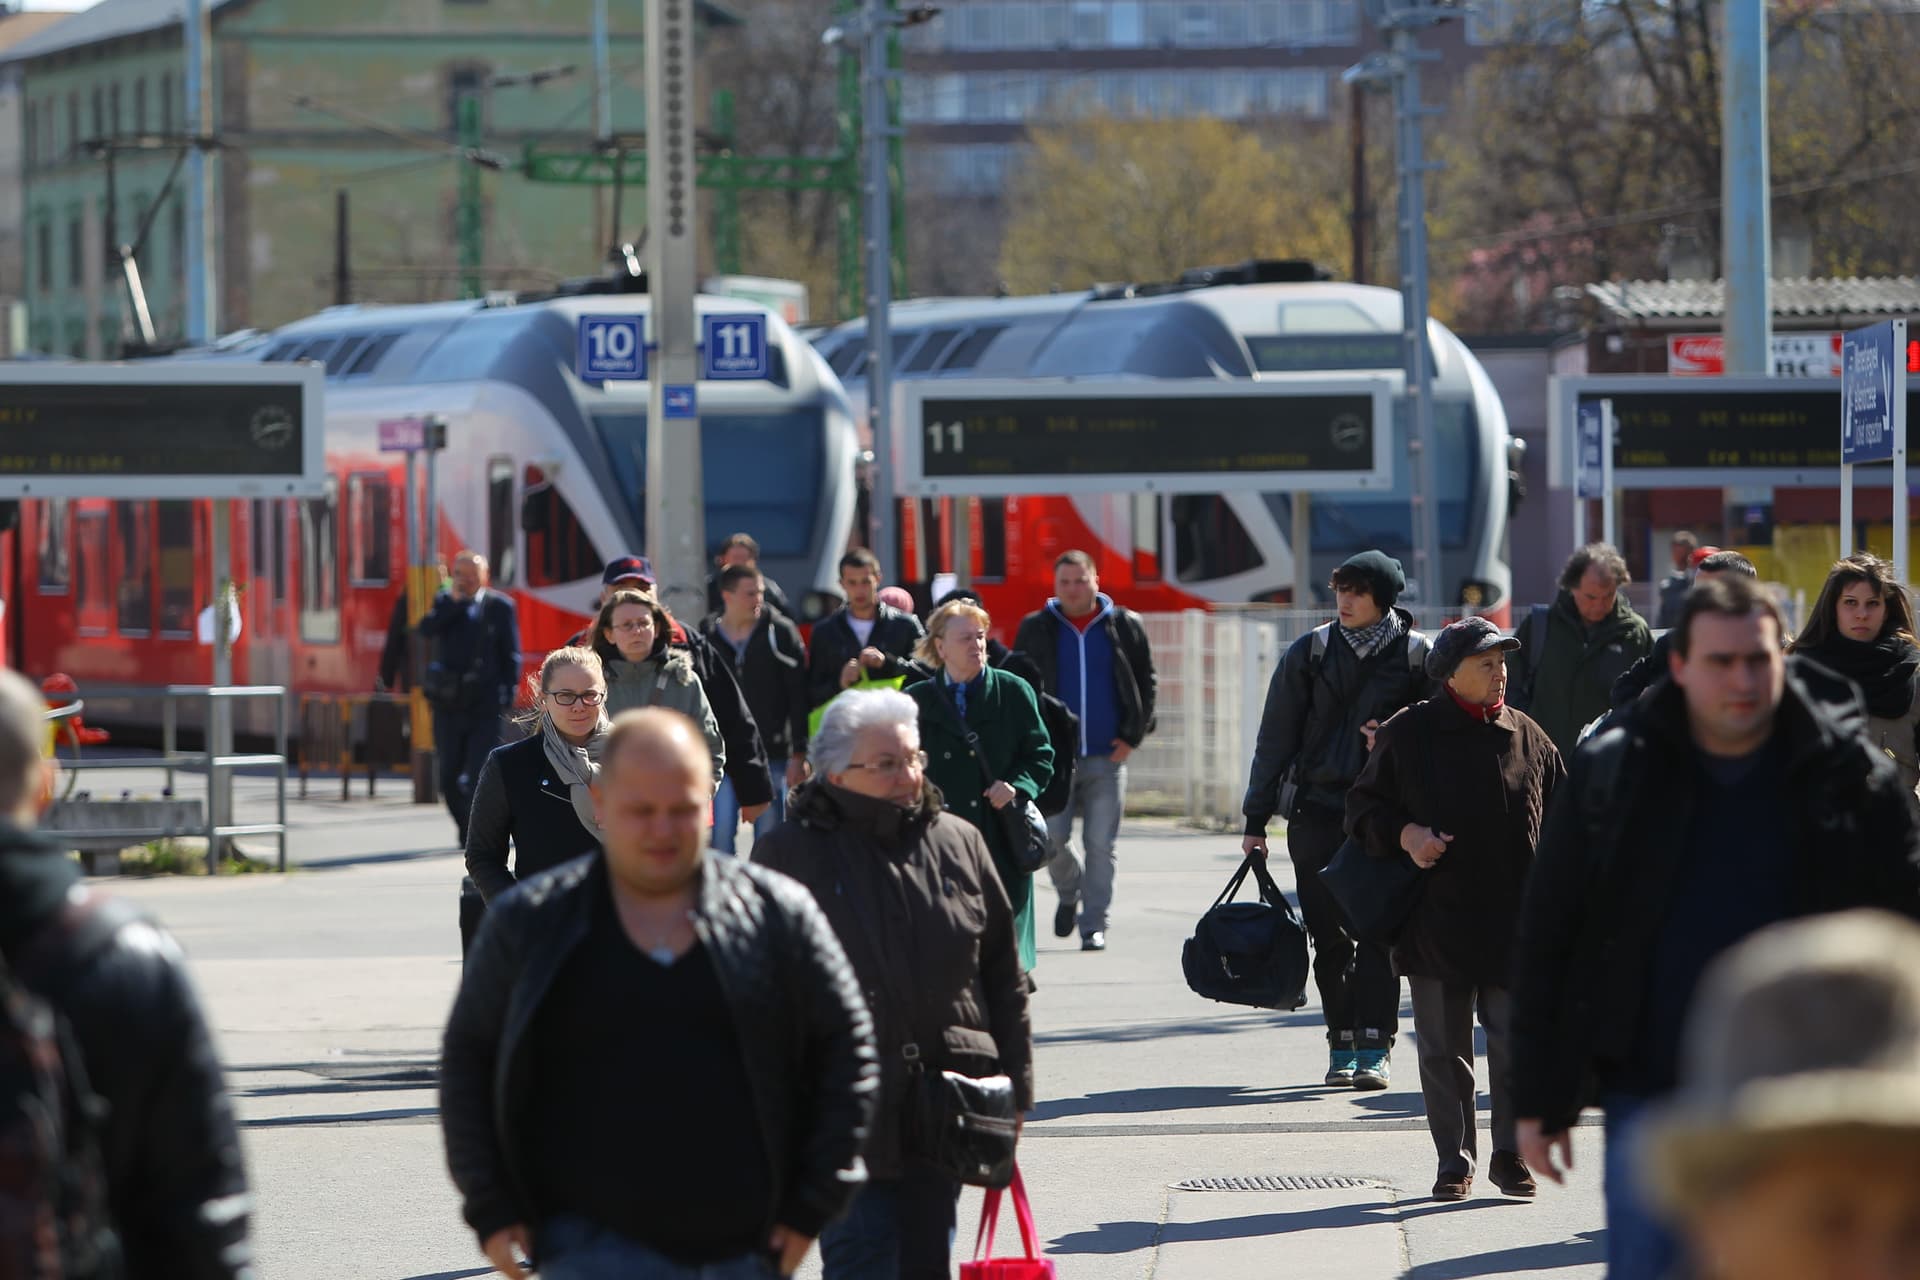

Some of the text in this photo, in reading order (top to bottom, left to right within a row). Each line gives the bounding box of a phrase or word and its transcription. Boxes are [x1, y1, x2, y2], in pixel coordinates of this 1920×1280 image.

[590, 324, 635, 358] 10
[717, 324, 751, 358] 11
[927, 420, 965, 453] 11
